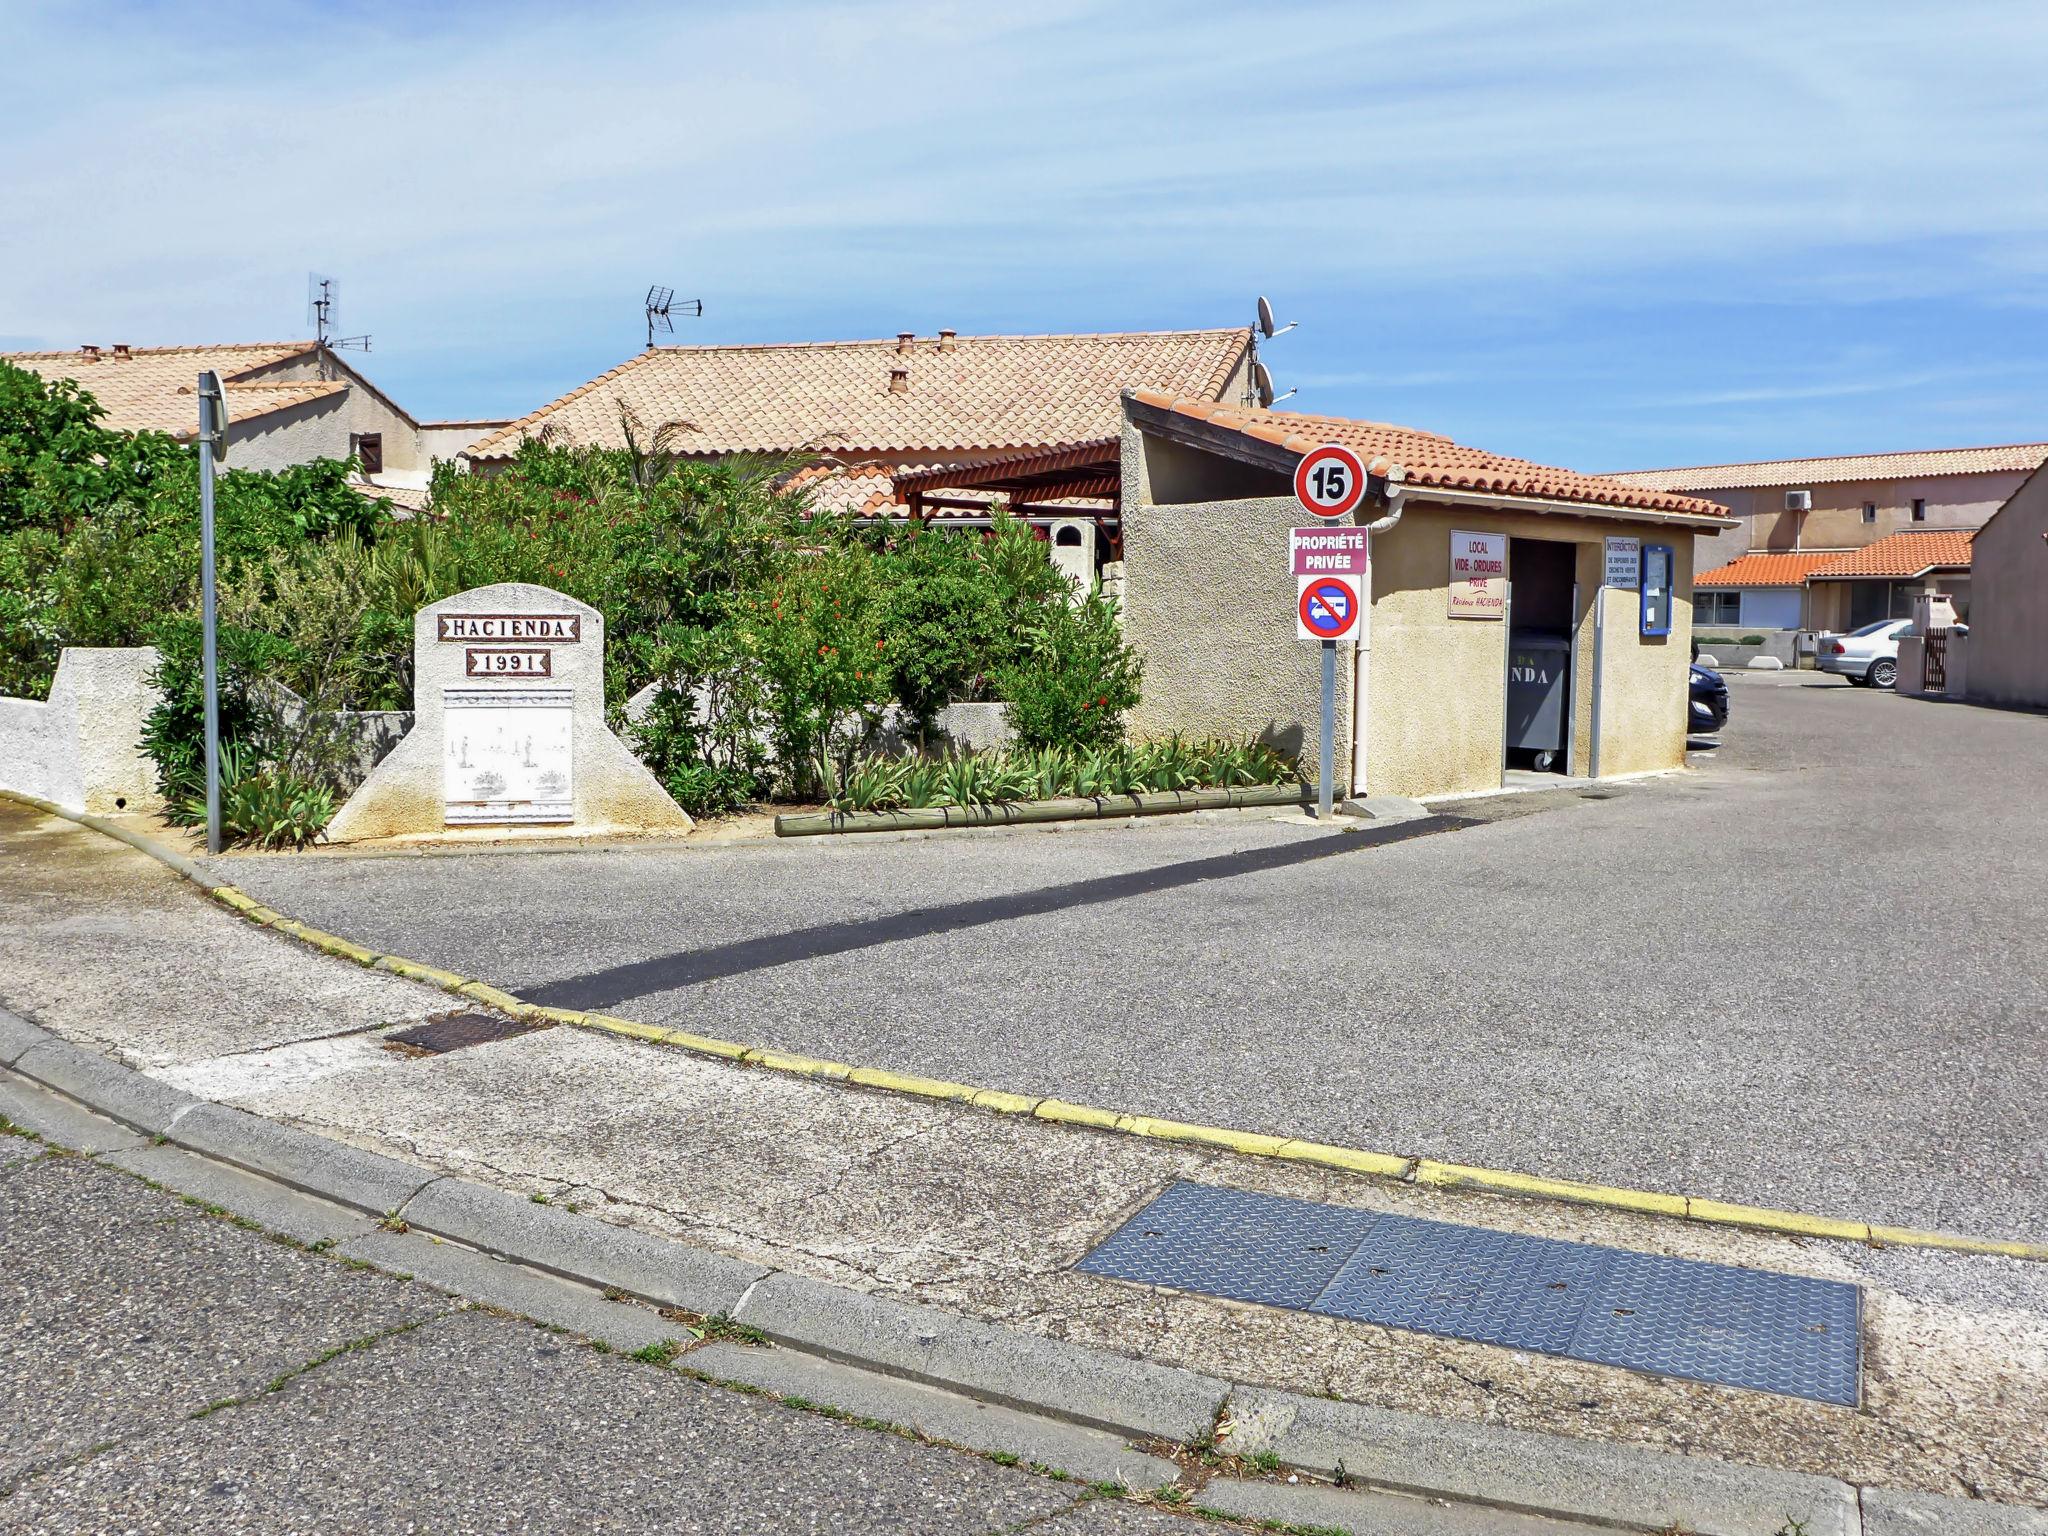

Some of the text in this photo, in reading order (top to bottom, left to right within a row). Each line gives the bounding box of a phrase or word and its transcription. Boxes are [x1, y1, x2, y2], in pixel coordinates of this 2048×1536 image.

[1312, 467, 1345, 499] 15
[1295, 533, 1364, 550] PROPRIÉTÉ
[1469, 541, 1488, 554] LOCAL
[1306, 553, 1351, 569] PRIVÉE
[1454, 558, 1469, 571] VIDE
[1474, 560, 1502, 573] ORDURES
[1469, 576, 1488, 588] PRIVÉ
[453, 620, 565, 636] HACIENDA
[485, 654, 533, 671] 1991
